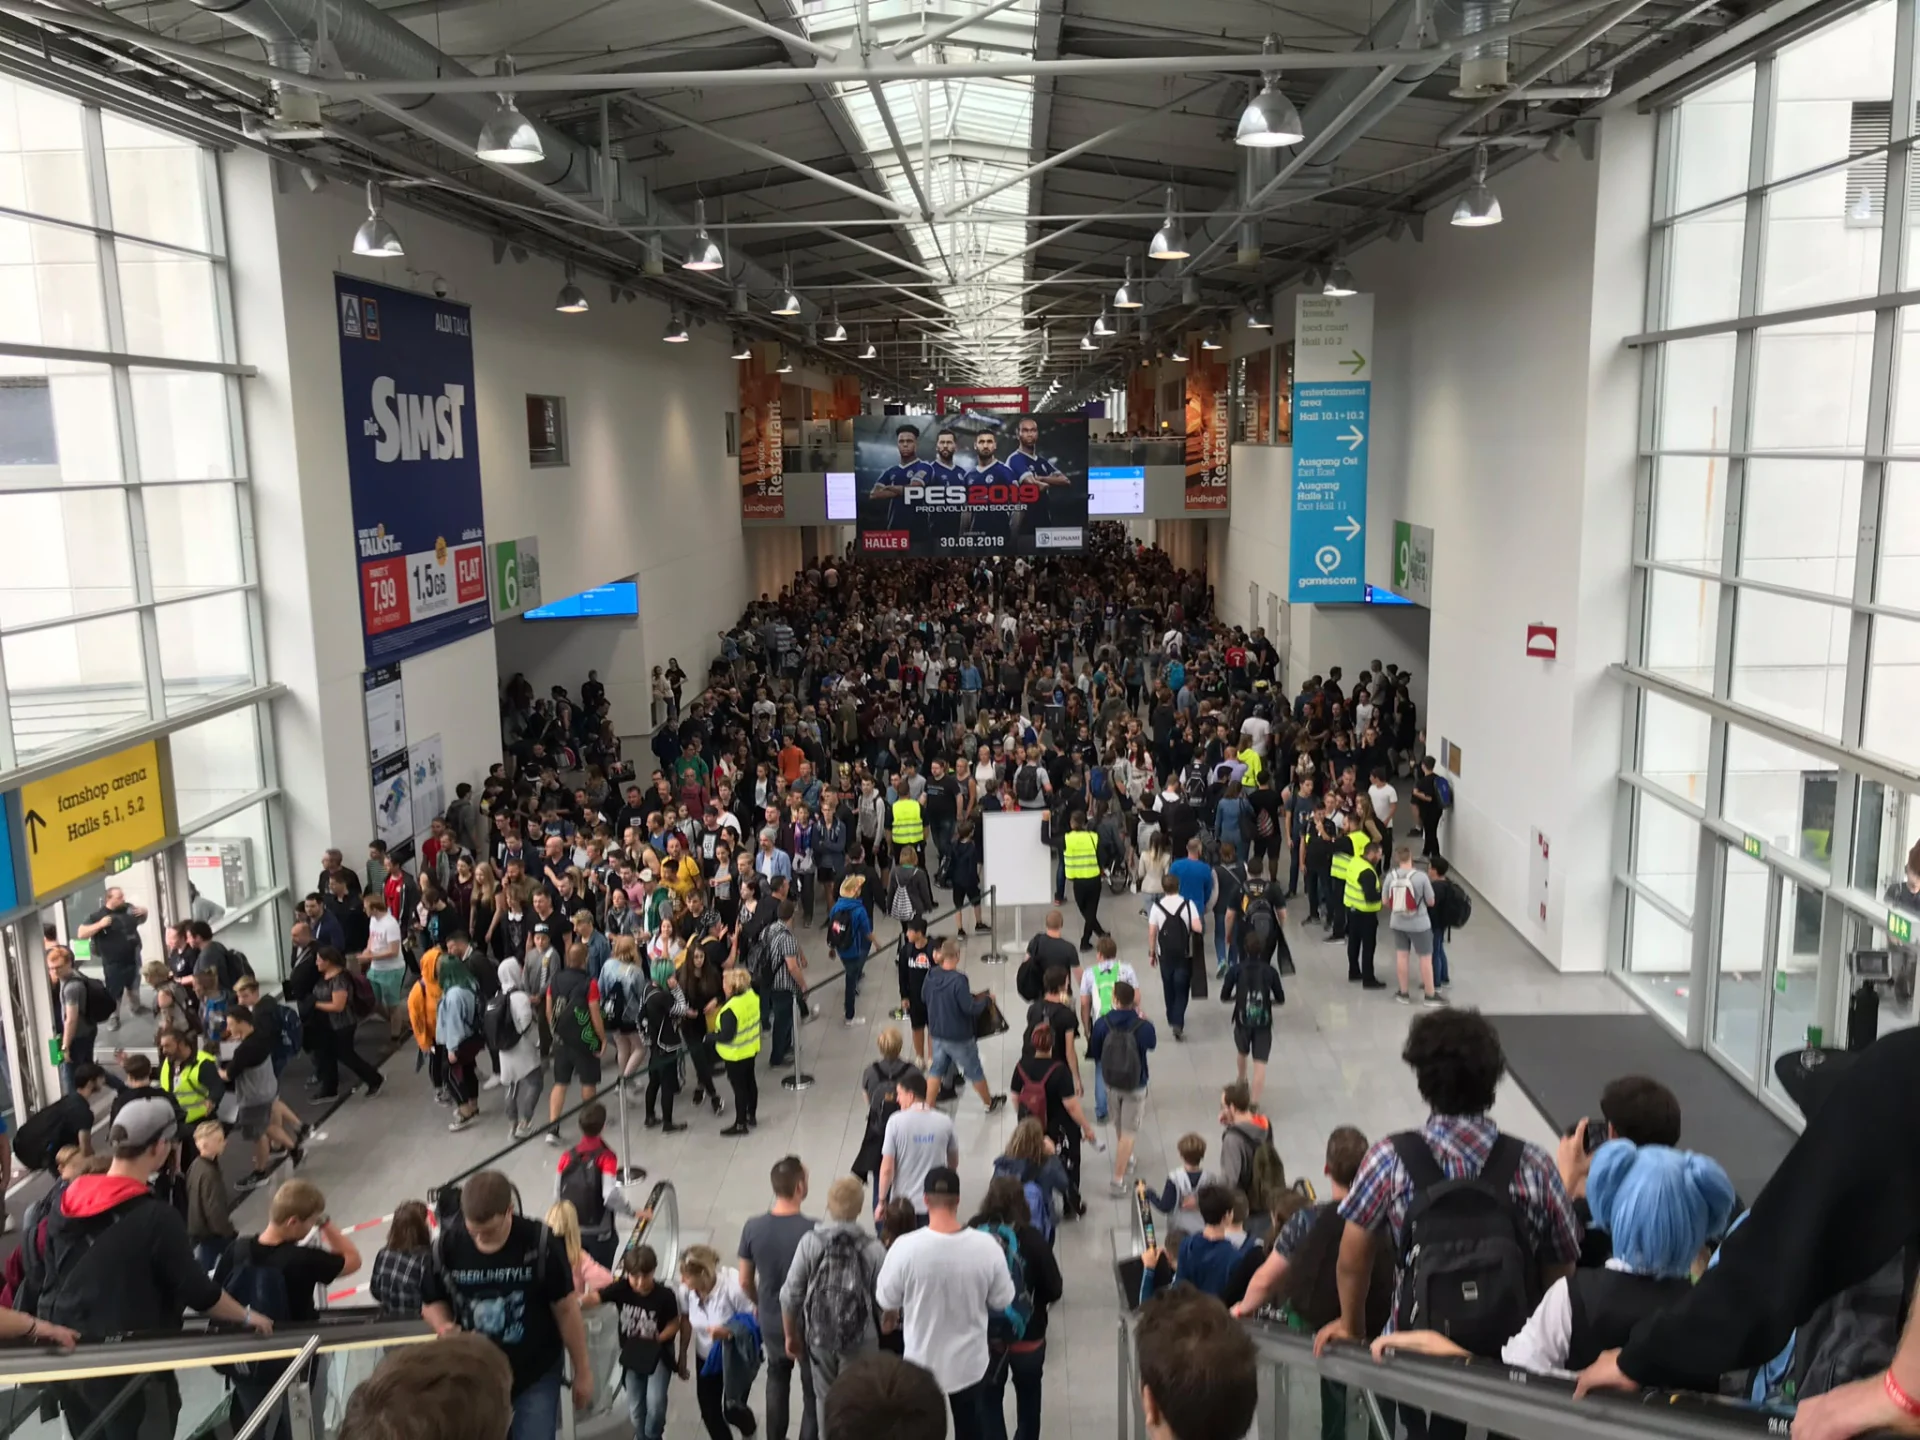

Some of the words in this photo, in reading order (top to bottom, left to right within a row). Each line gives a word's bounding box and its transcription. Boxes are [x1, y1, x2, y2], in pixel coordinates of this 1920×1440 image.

[435, 312, 452, 335] ALDI
[452, 316, 470, 337] TALK
[1324, 323, 1349, 332] court
[1302, 337, 1321, 346] Hall
[1300, 388, 1365, 397] entertainment
[1299, 399, 1322, 407] area
[1299, 412, 1319, 421] Hall
[1322, 411, 1365, 420] 10.1+10.2
[363, 417, 379, 436] Die
[1212, 390, 1227, 487] Restaurant
[768, 400, 783, 496] Restaurant
[1201, 432, 1210, 466] Service
[757, 441, 766, 478] Service
[1298, 457, 1341, 467] Ausgang
[1342, 457, 1358, 466] Ost
[1201, 470, 1210, 487] Self
[1298, 468, 1315, 477] Exit
[1317, 468, 1335, 477] East
[758, 479, 766, 496] Self
[1297, 481, 1340, 491] Ausgang
[904, 485, 966, 505] PES
[967, 484, 1040, 504] 2019
[1186, 495, 1226, 505] Lindbergh
[1297, 492, 1322, 501] Halle
[1324, 491, 1334, 500] 11
[744, 503, 784, 516] Lindbergh
[915, 505, 935, 513] PRO
[936, 505, 988, 513] EVOLUTION
[989, 503, 1028, 512] SOCCER
[1297, 502, 1314, 511] Exit
[1316, 502, 1335, 511] Hall
[1337, 501, 1347, 510] 11
[865, 538, 898, 549] HALLE
[900, 538, 908, 548] 8
[940, 536, 1005, 548] 30.08.2018
[458, 556, 481, 584] FLAT
[1400, 541, 1410, 589] 9
[504, 559, 518, 608] 6
[1298, 576, 1357, 588] gamescom
[370, 578, 397, 615] 7,99
[57, 780, 109, 813] fanshop
[111, 767, 147, 792] arena
[66, 816, 100, 842] Halls
[102, 806, 125, 827] 5.1,
[127, 796, 145, 817] 5.2
